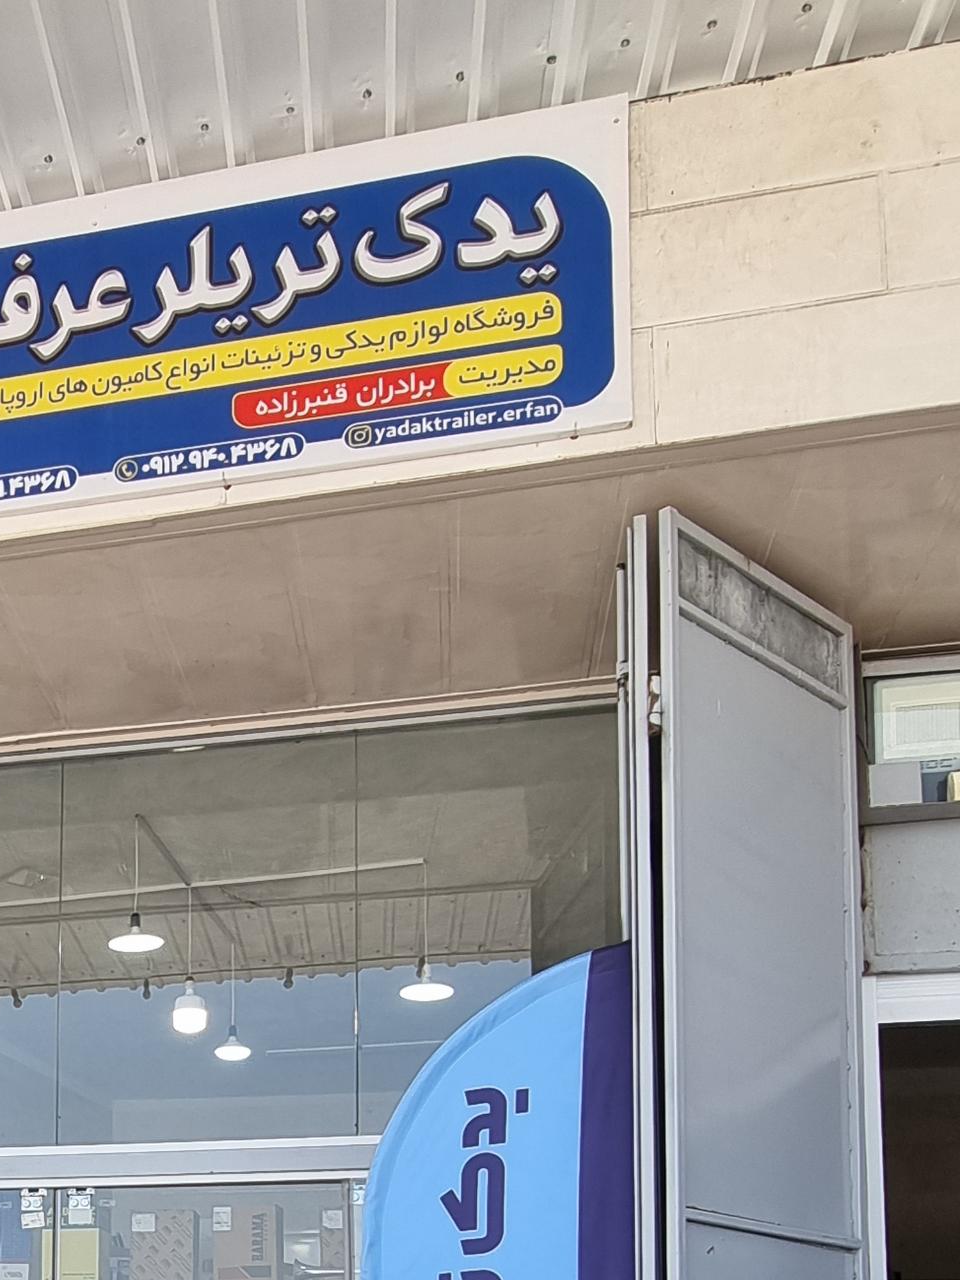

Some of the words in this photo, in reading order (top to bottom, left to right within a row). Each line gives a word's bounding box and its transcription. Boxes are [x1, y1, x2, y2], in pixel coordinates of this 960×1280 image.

[354, 182, 561, 284] یدک
[132, 206, 341, 343] تریلر
[453, 299, 555, 333] فروشگاه
[326, 330, 386, 358] یدکی
[389, 317, 448, 350] لوازم
[221, 341, 305, 371] تزئینات
[310, 344, 322, 362] و
[92, 361, 163, 394] کامیون
[165, 353, 216, 390] انواع
[458, 356, 557, 388] مدیریت
[48, 377, 88, 403] های
[255, 384, 348, 418] قنبرزاده
[356, 372, 436, 407] برادران
[374, 401, 559, 446] yadaktrailer.erfan
[440, 1086, 530, 1256] یدک
